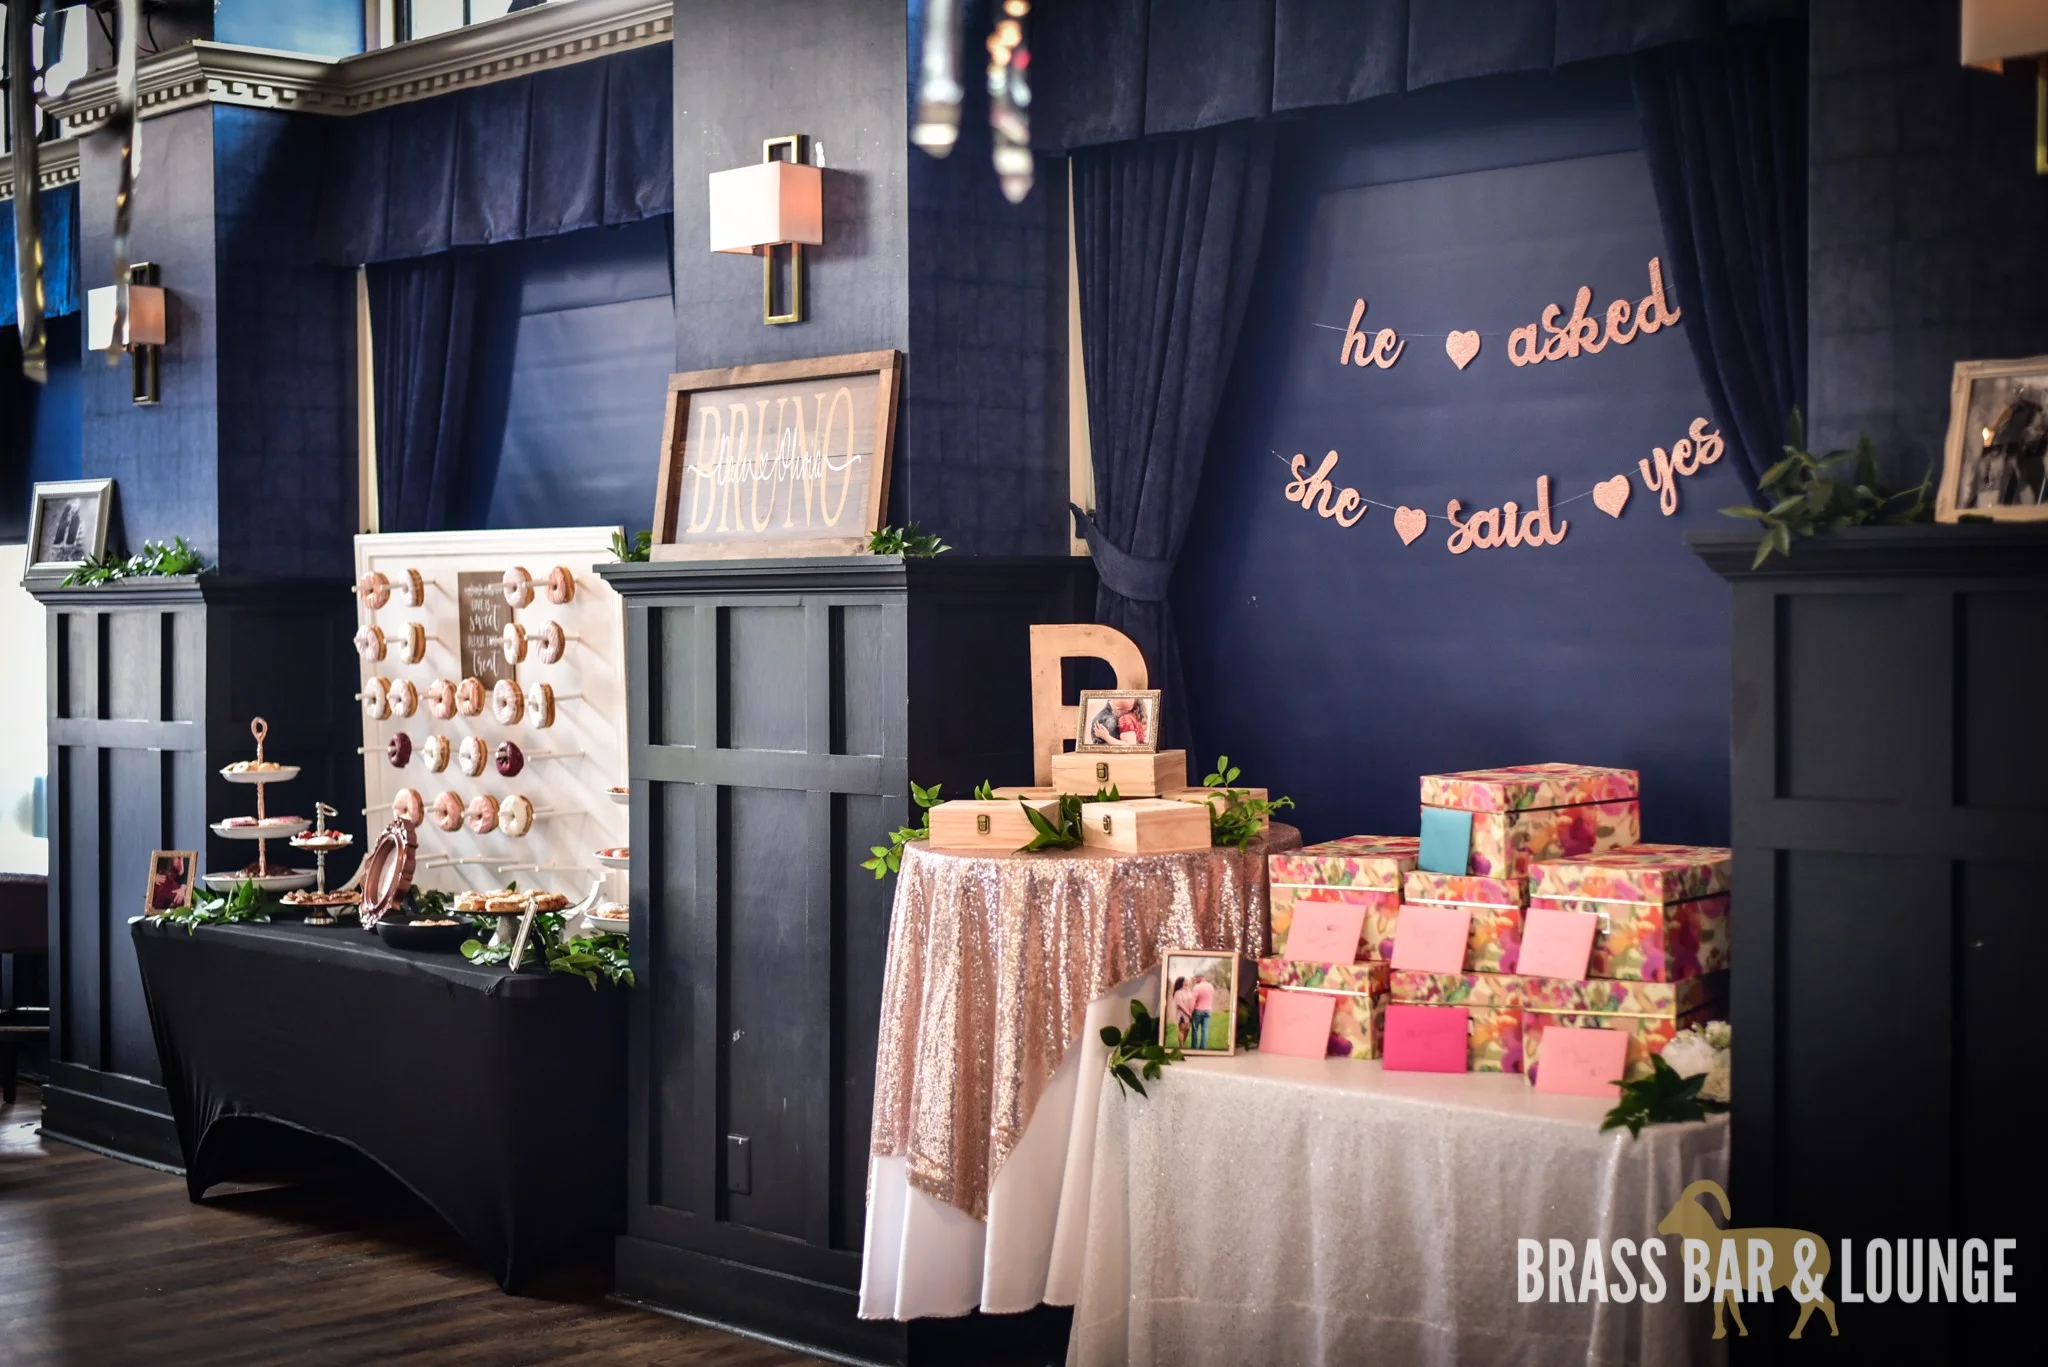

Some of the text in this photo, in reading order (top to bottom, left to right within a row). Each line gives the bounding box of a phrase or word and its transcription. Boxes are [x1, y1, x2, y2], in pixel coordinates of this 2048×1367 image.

[1340, 256, 1682, 369] he asked
[686, 387, 854, 533] BRUNO
[1285, 417, 1725, 554] she said yes
[469, 604, 501, 632] sweet
[471, 598, 491, 612] LOVE IS
[470, 648, 501, 677] treat
